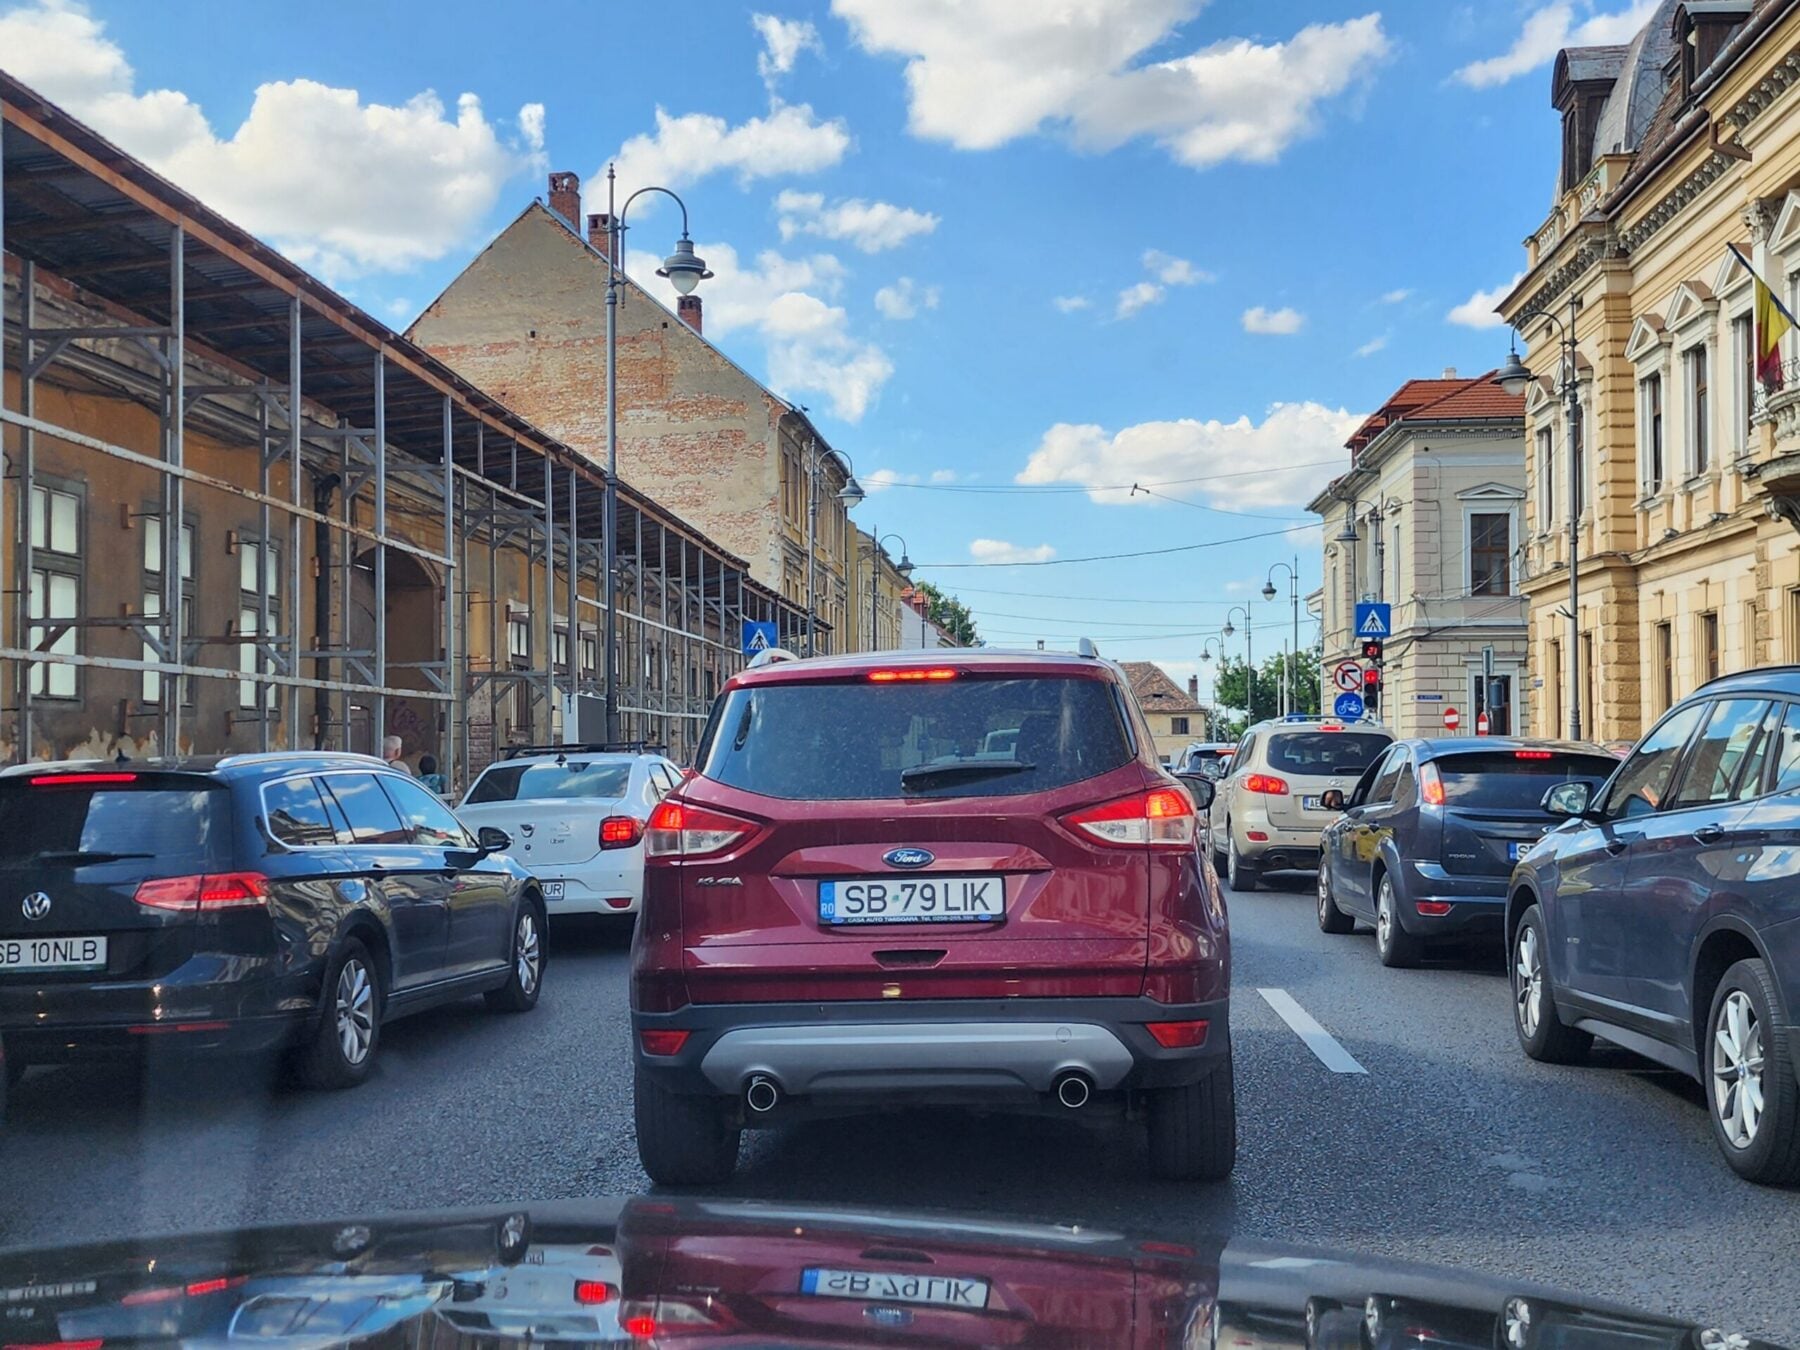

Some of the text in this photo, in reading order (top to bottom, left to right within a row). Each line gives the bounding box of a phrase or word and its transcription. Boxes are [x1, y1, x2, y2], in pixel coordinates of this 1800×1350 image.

[894, 850, 922, 863] Ford
[541, 884, 562, 895] UR
[821, 902, 834, 915] RO
